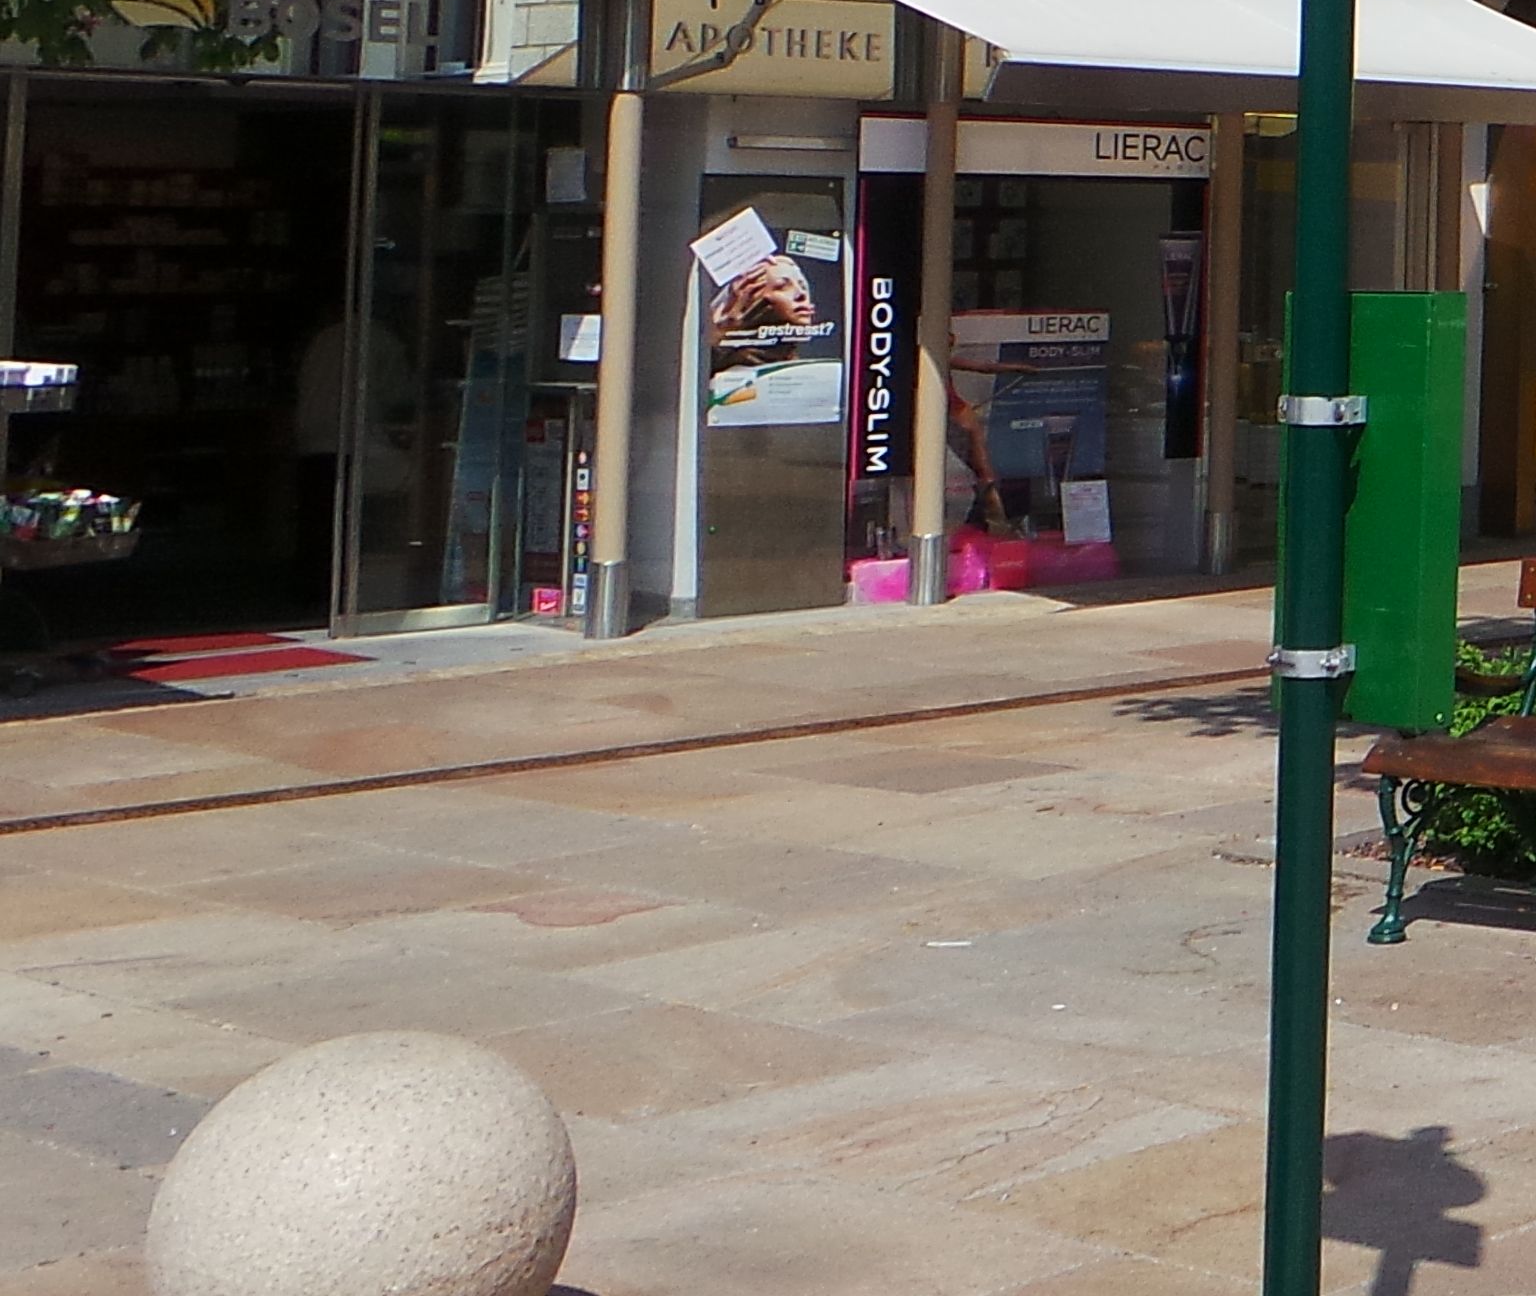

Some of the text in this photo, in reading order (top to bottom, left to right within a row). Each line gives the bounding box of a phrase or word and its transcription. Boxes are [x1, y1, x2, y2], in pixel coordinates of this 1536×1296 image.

[1095, 132, 1206, 163] LIERAC
[1027, 315, 1101, 335] LIERAC
[865, 277, 893, 472] BODY-SLIM
